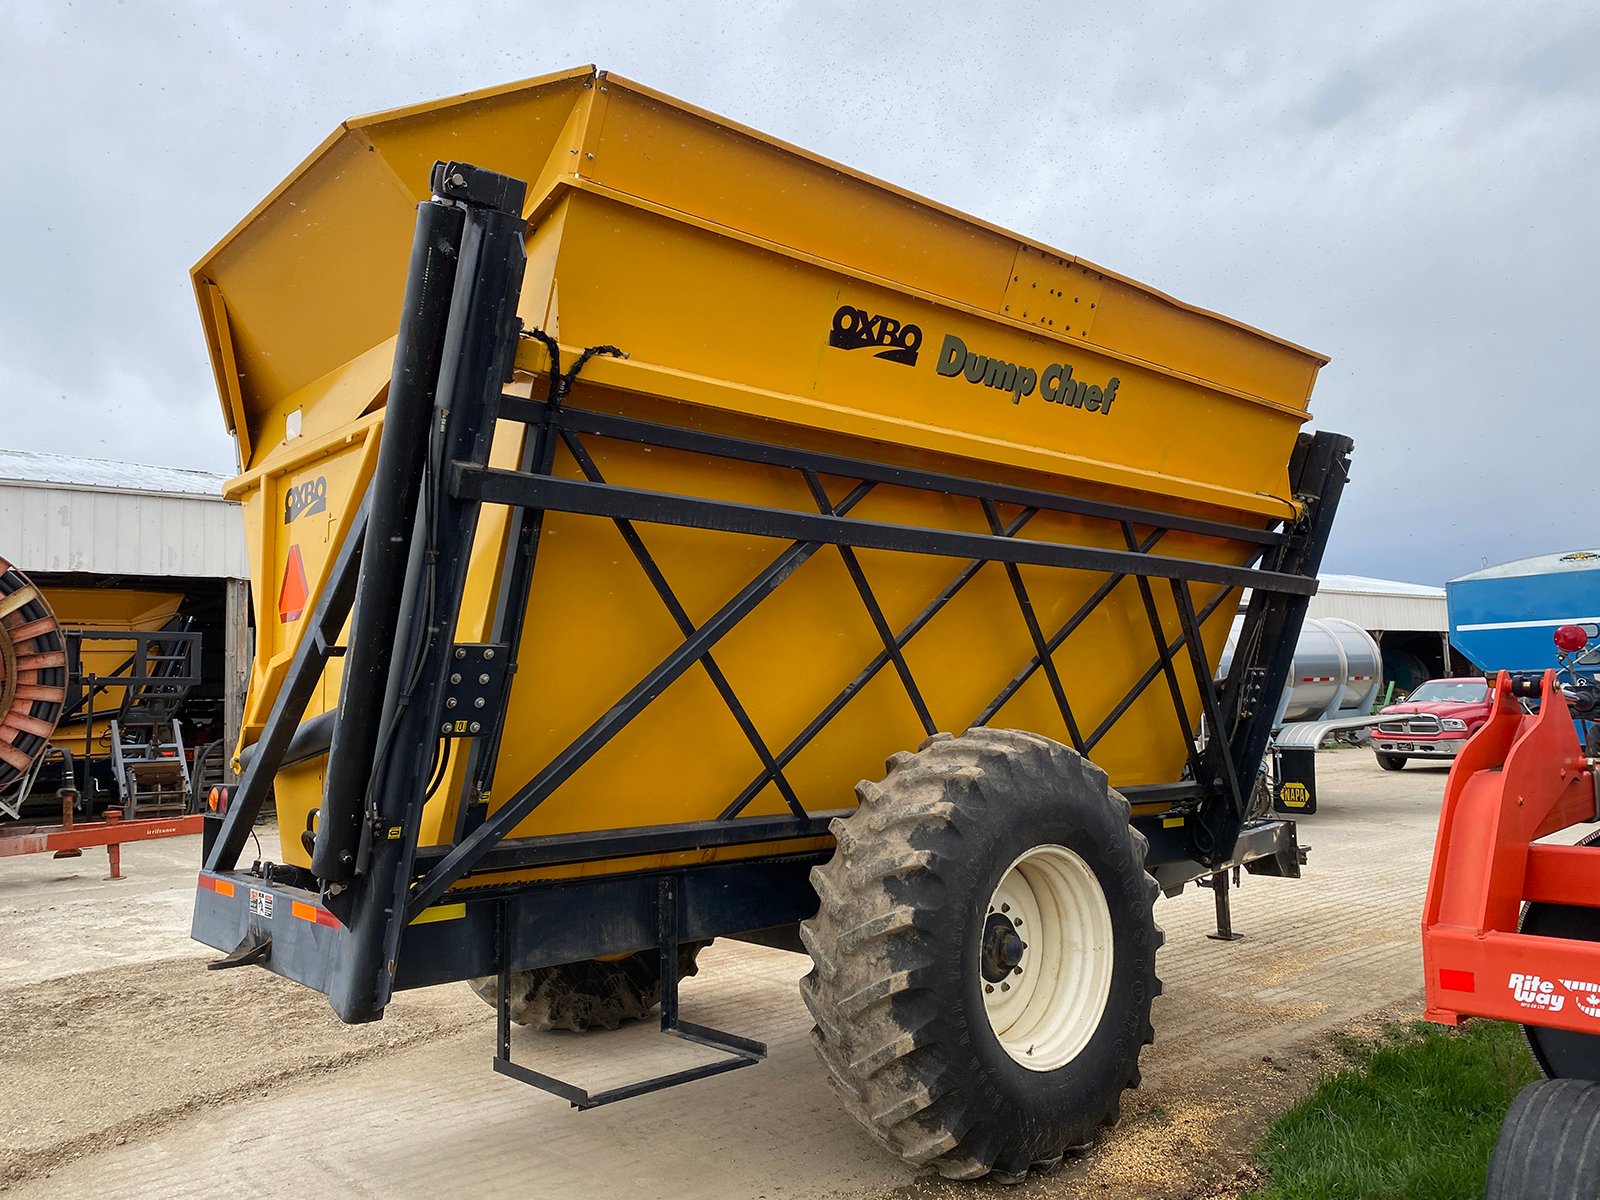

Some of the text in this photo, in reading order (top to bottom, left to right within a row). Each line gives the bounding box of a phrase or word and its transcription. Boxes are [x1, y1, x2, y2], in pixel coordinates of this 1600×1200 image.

[829, 305, 922, 356] OXBO
[936, 333, 1121, 415] Dump Chief
[285, 476, 326, 517] OXBO
[1284, 787, 1305, 802] NAPA
[1508, 973, 1555, 995] Rite
